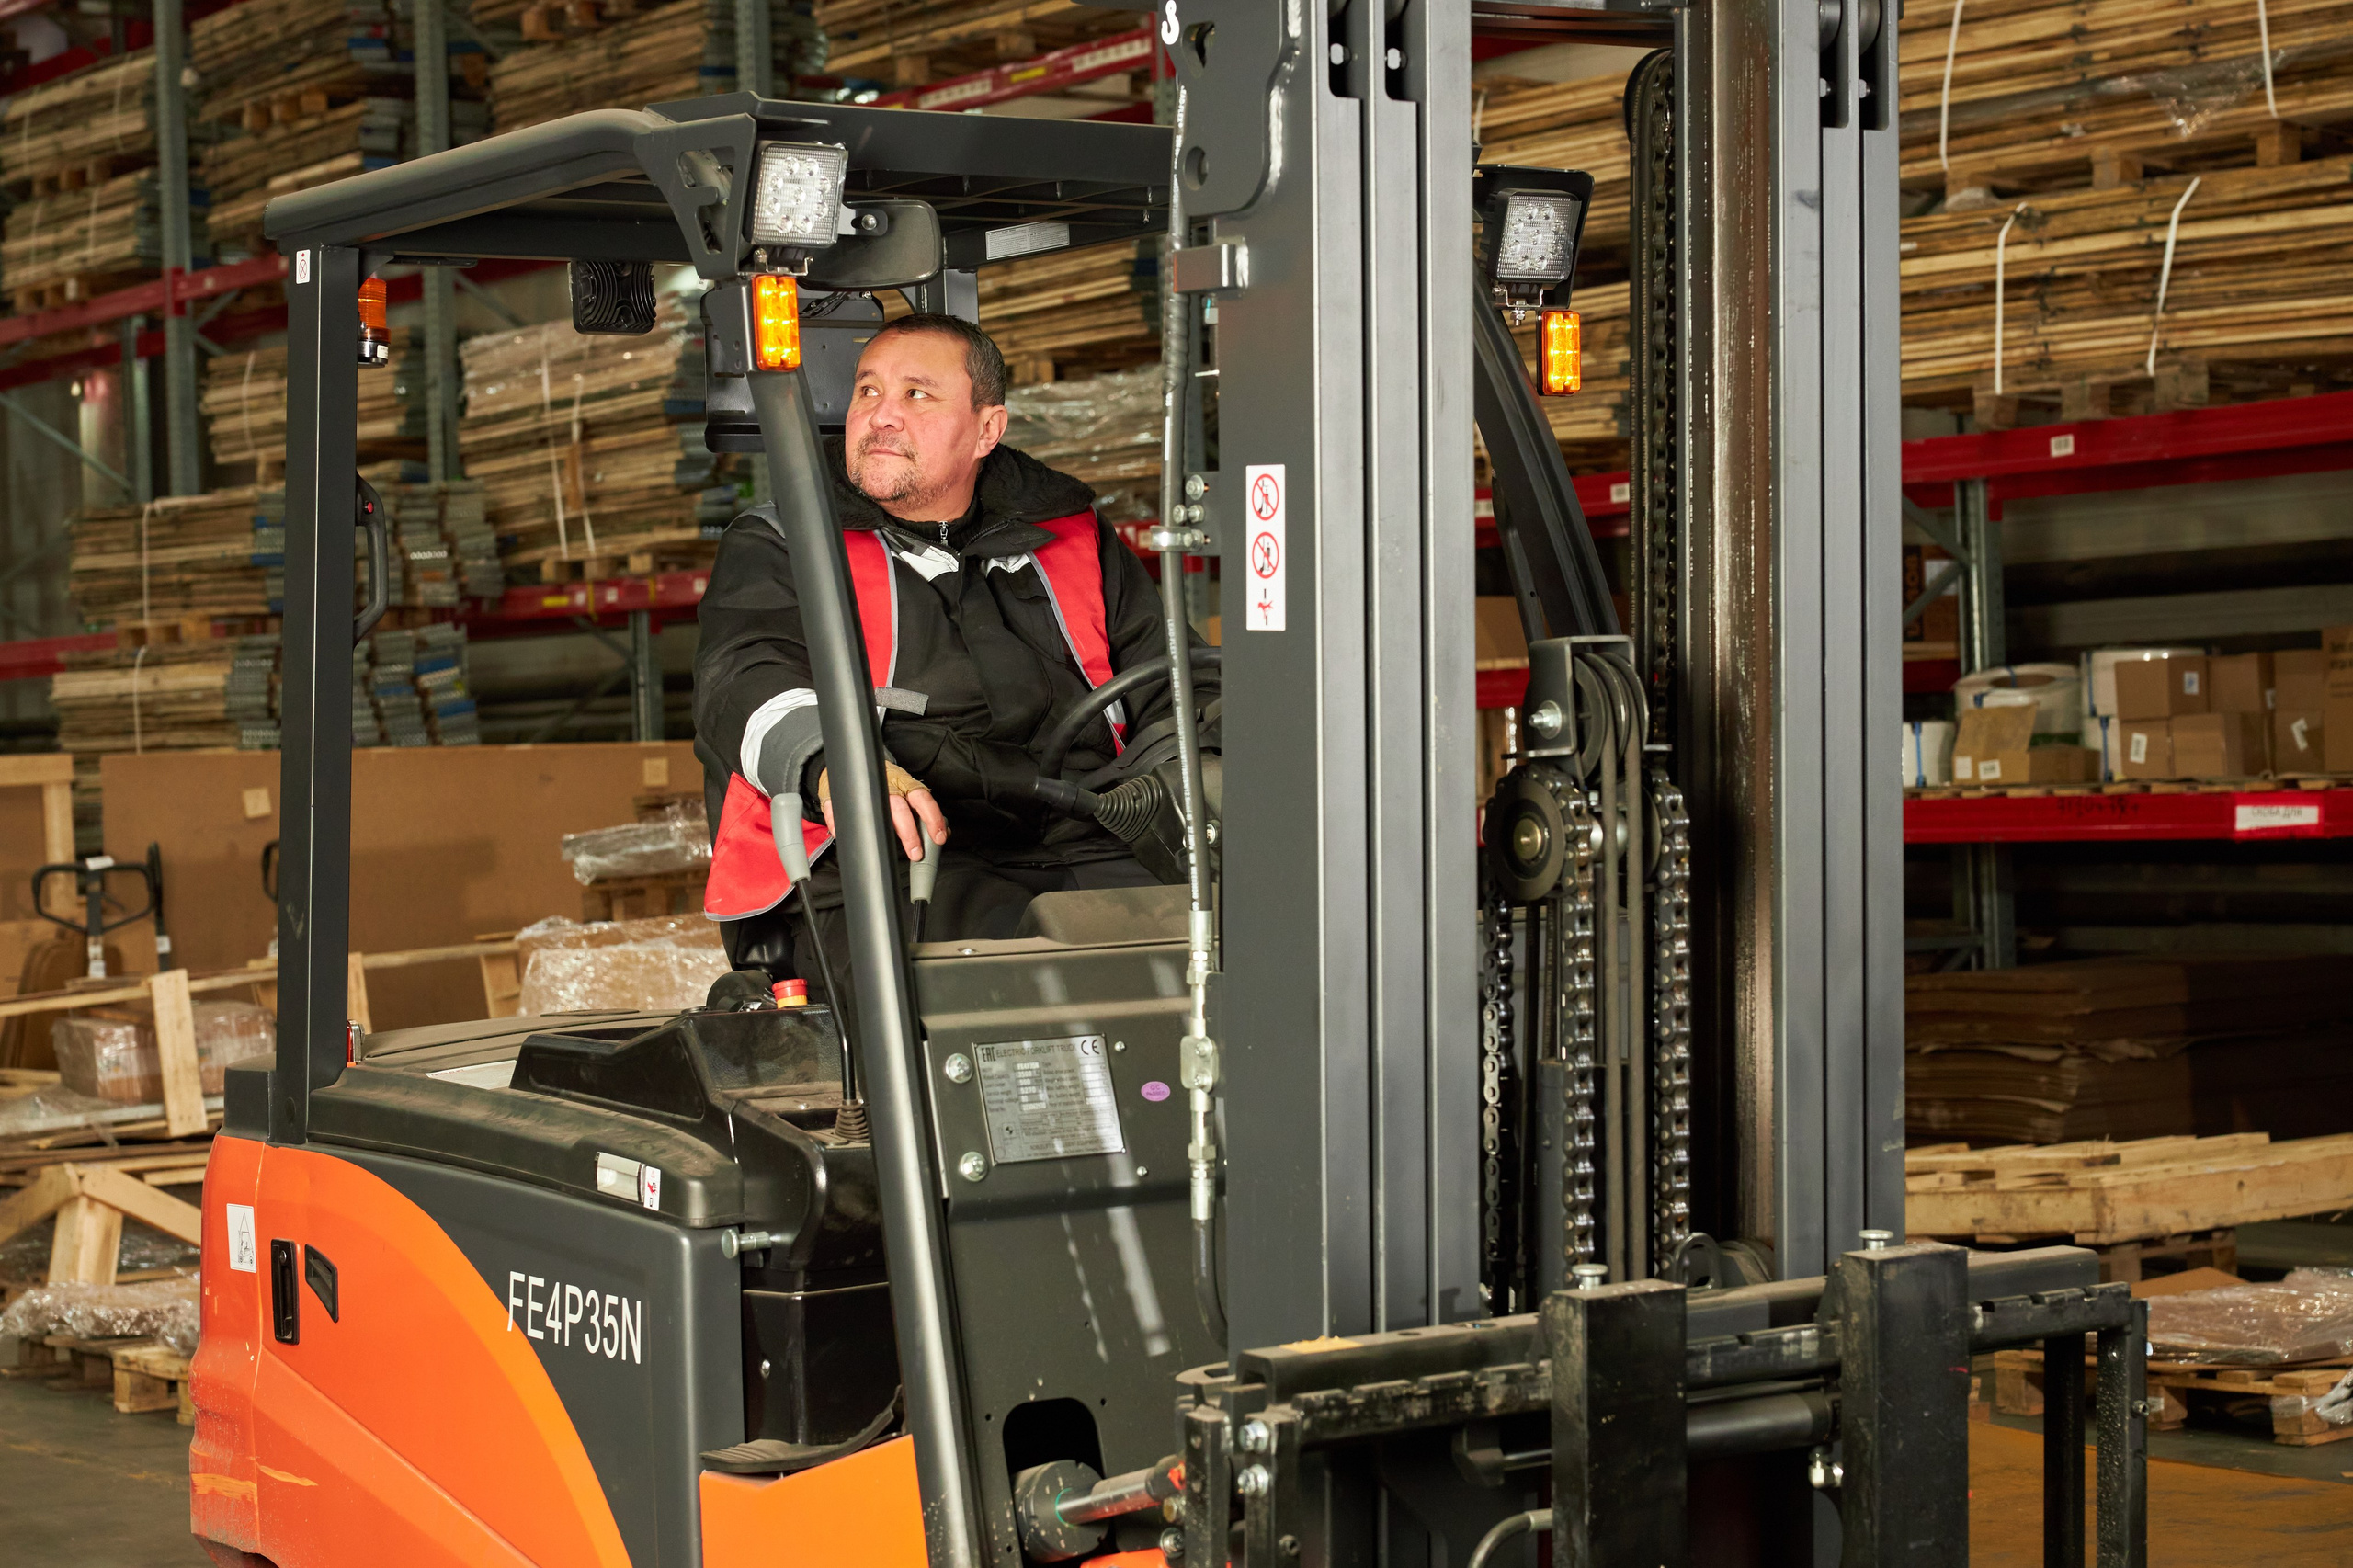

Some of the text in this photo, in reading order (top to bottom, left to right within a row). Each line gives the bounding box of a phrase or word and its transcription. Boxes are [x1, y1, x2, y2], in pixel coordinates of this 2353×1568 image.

[996, 1048, 1026, 1058] ELECTRIC
[1027, 1045, 1054, 1055] FORKLIFT
[1081, 1039, 1100, 1055] CE
[507, 1271, 642, 1365] FE4P35N
